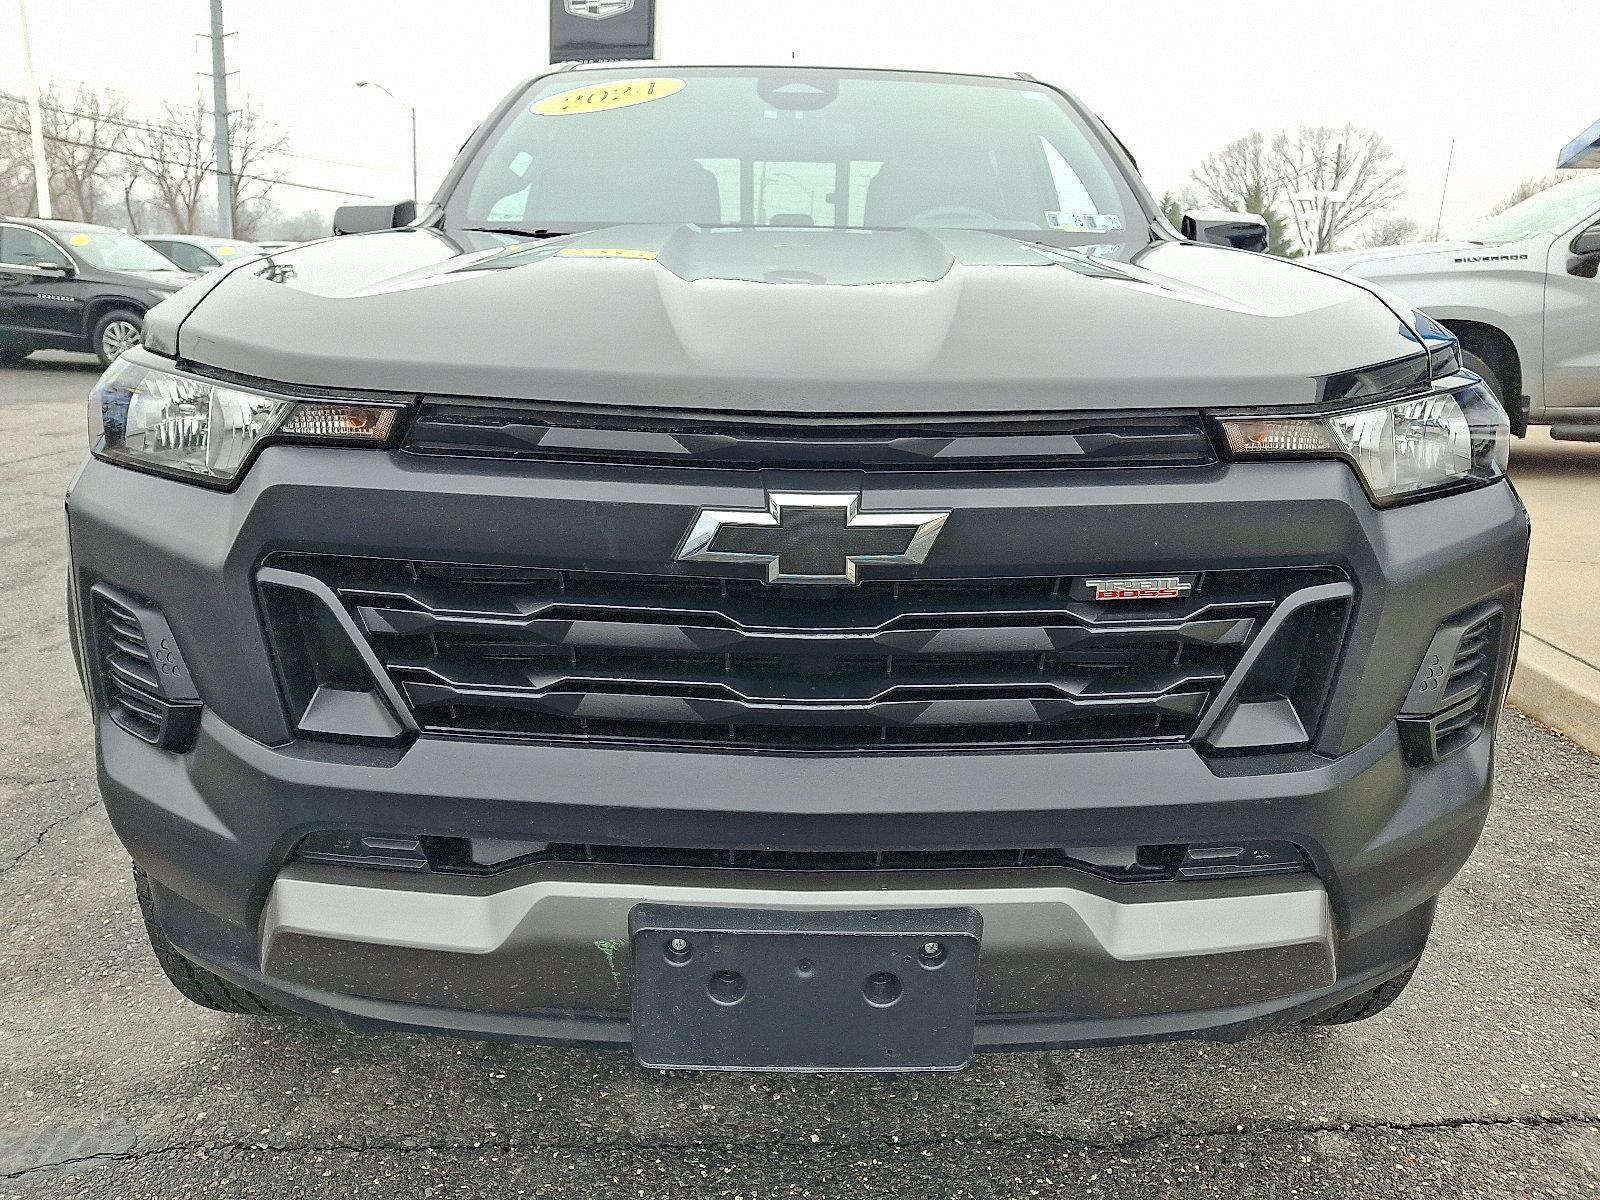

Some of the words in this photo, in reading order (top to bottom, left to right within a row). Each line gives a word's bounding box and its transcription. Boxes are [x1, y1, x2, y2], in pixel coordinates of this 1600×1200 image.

[1454, 254, 1528, 263] SILVERADO
[1085, 577, 1192, 592] TRAIL
[1095, 588, 1179, 601] BOSS
